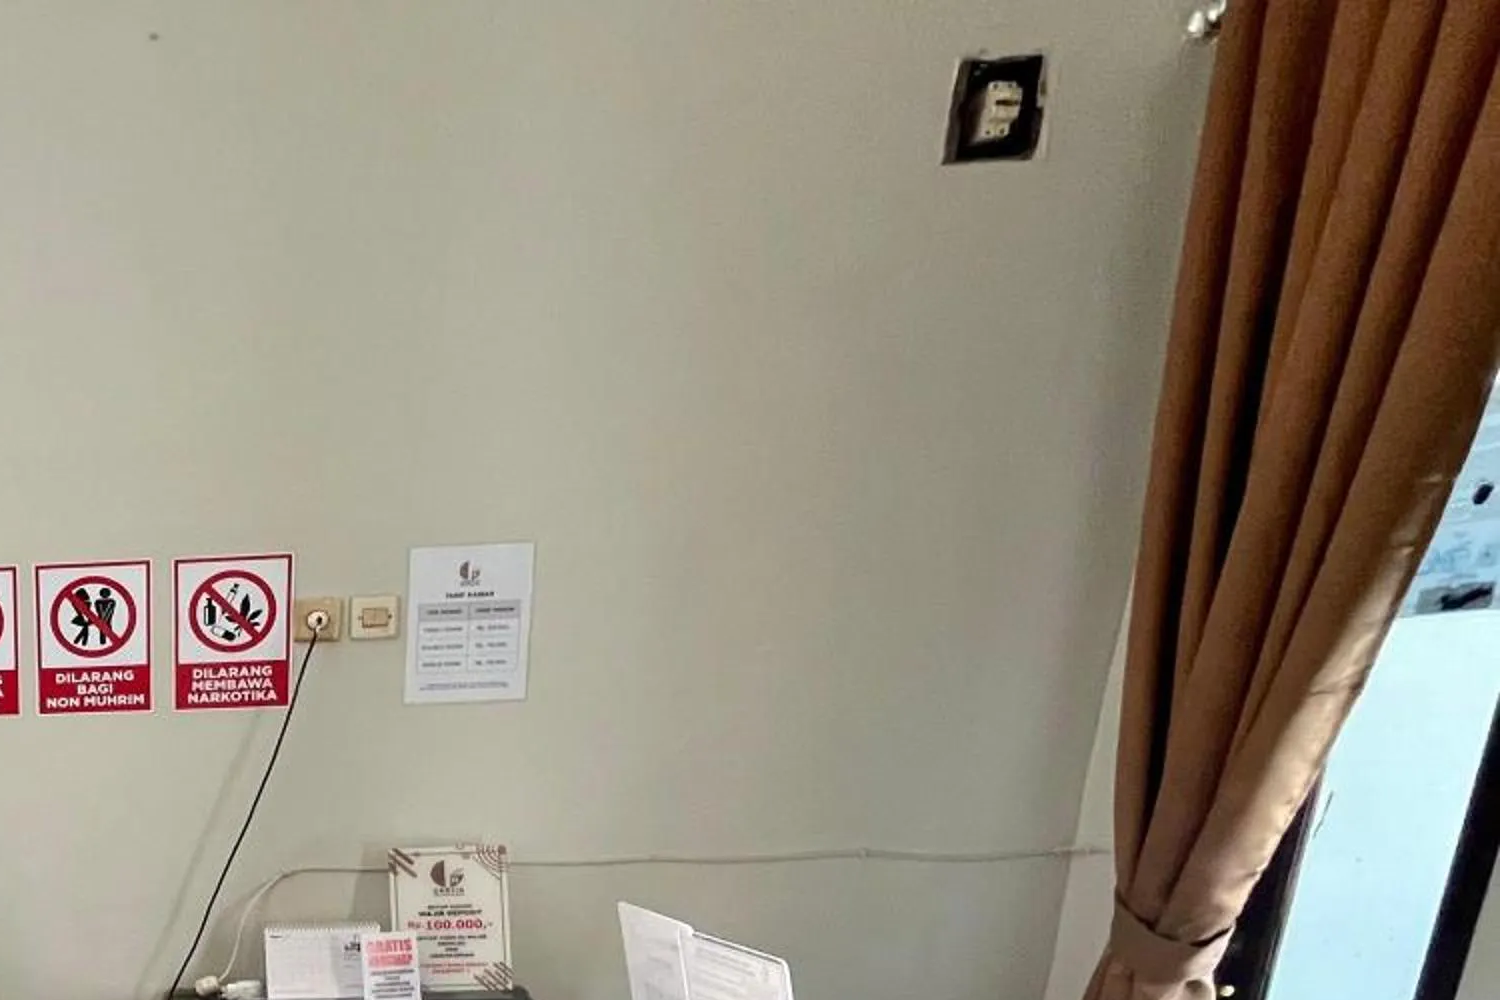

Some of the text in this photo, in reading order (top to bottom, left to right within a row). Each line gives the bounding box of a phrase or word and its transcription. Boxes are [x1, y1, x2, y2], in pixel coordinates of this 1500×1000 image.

[55, 669, 135, 684] DILARANG
[192, 665, 273, 679] DILARANG
[77, 683, 113, 695] BAGI
[191, 678, 273, 691] MEMBAWA
[46, 697, 80, 708] NON
[187, 689, 277, 704] NARKOTIKA
